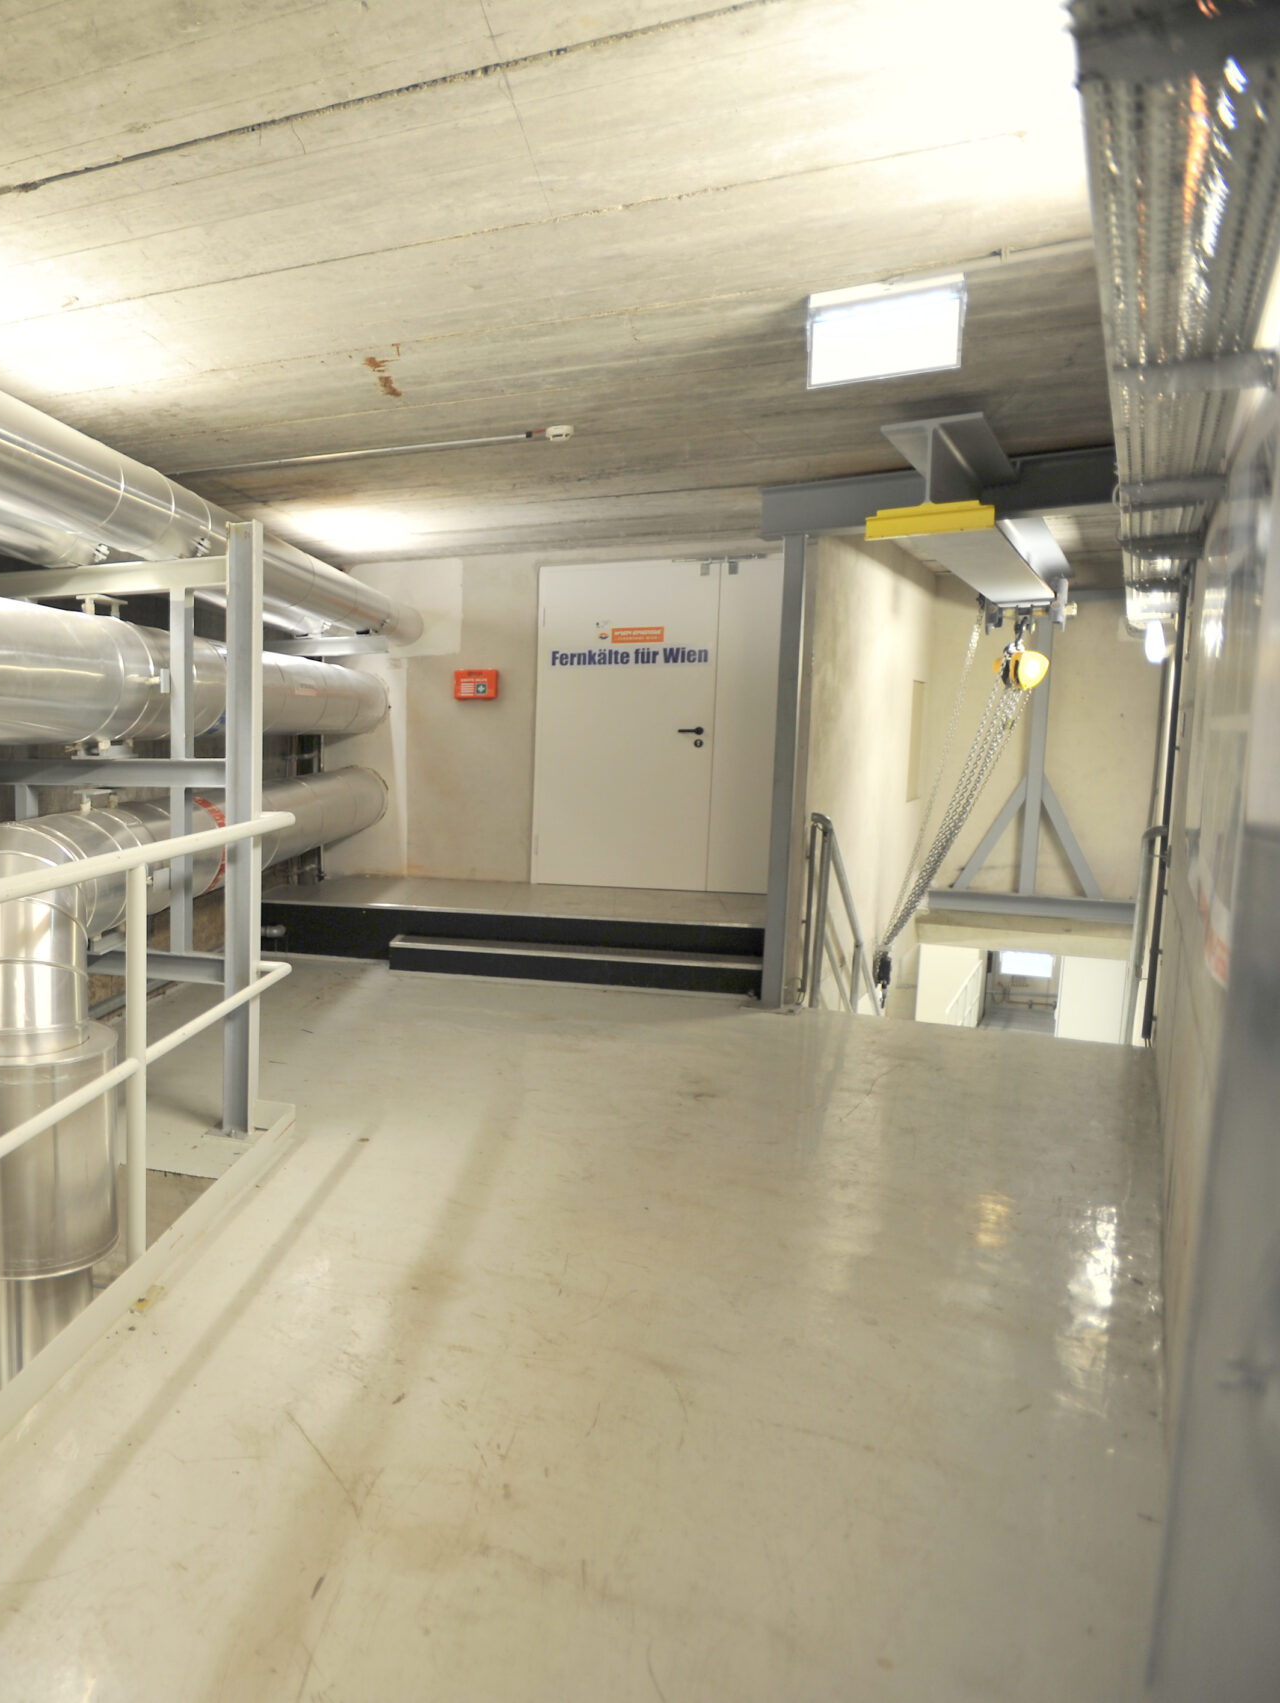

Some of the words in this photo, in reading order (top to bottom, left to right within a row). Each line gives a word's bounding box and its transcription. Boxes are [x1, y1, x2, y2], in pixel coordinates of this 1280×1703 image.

[551, 649, 630, 666] Fernkälte
[634, 648, 659, 665] für
[663, 647, 708, 664] Wien
